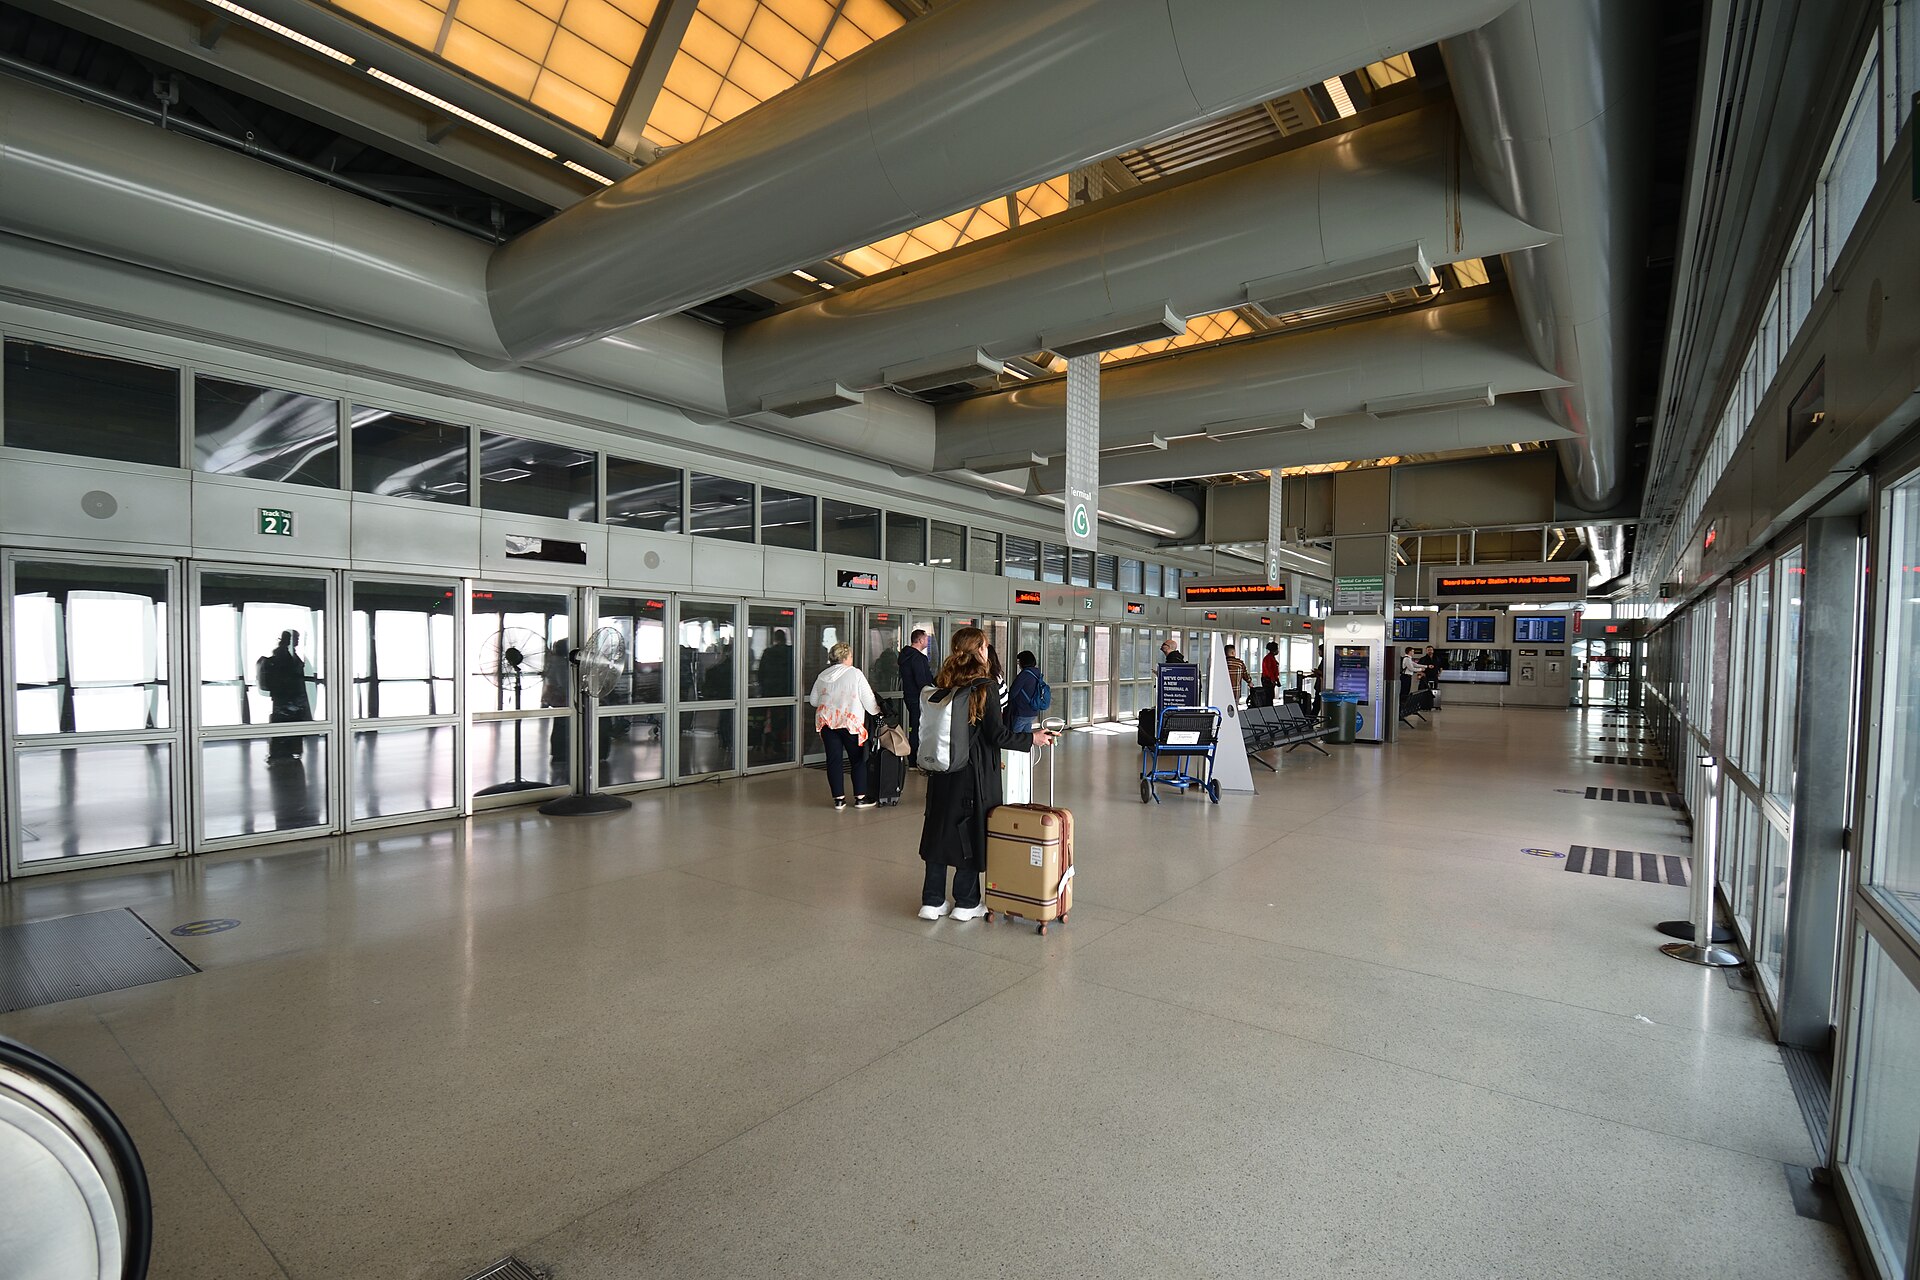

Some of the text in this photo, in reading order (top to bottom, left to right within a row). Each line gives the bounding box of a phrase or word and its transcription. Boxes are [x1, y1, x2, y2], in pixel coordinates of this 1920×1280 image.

[1070, 486, 1091, 500] Terminal
[265, 517, 277, 533] 2
[282, 519, 290, 534] 2
